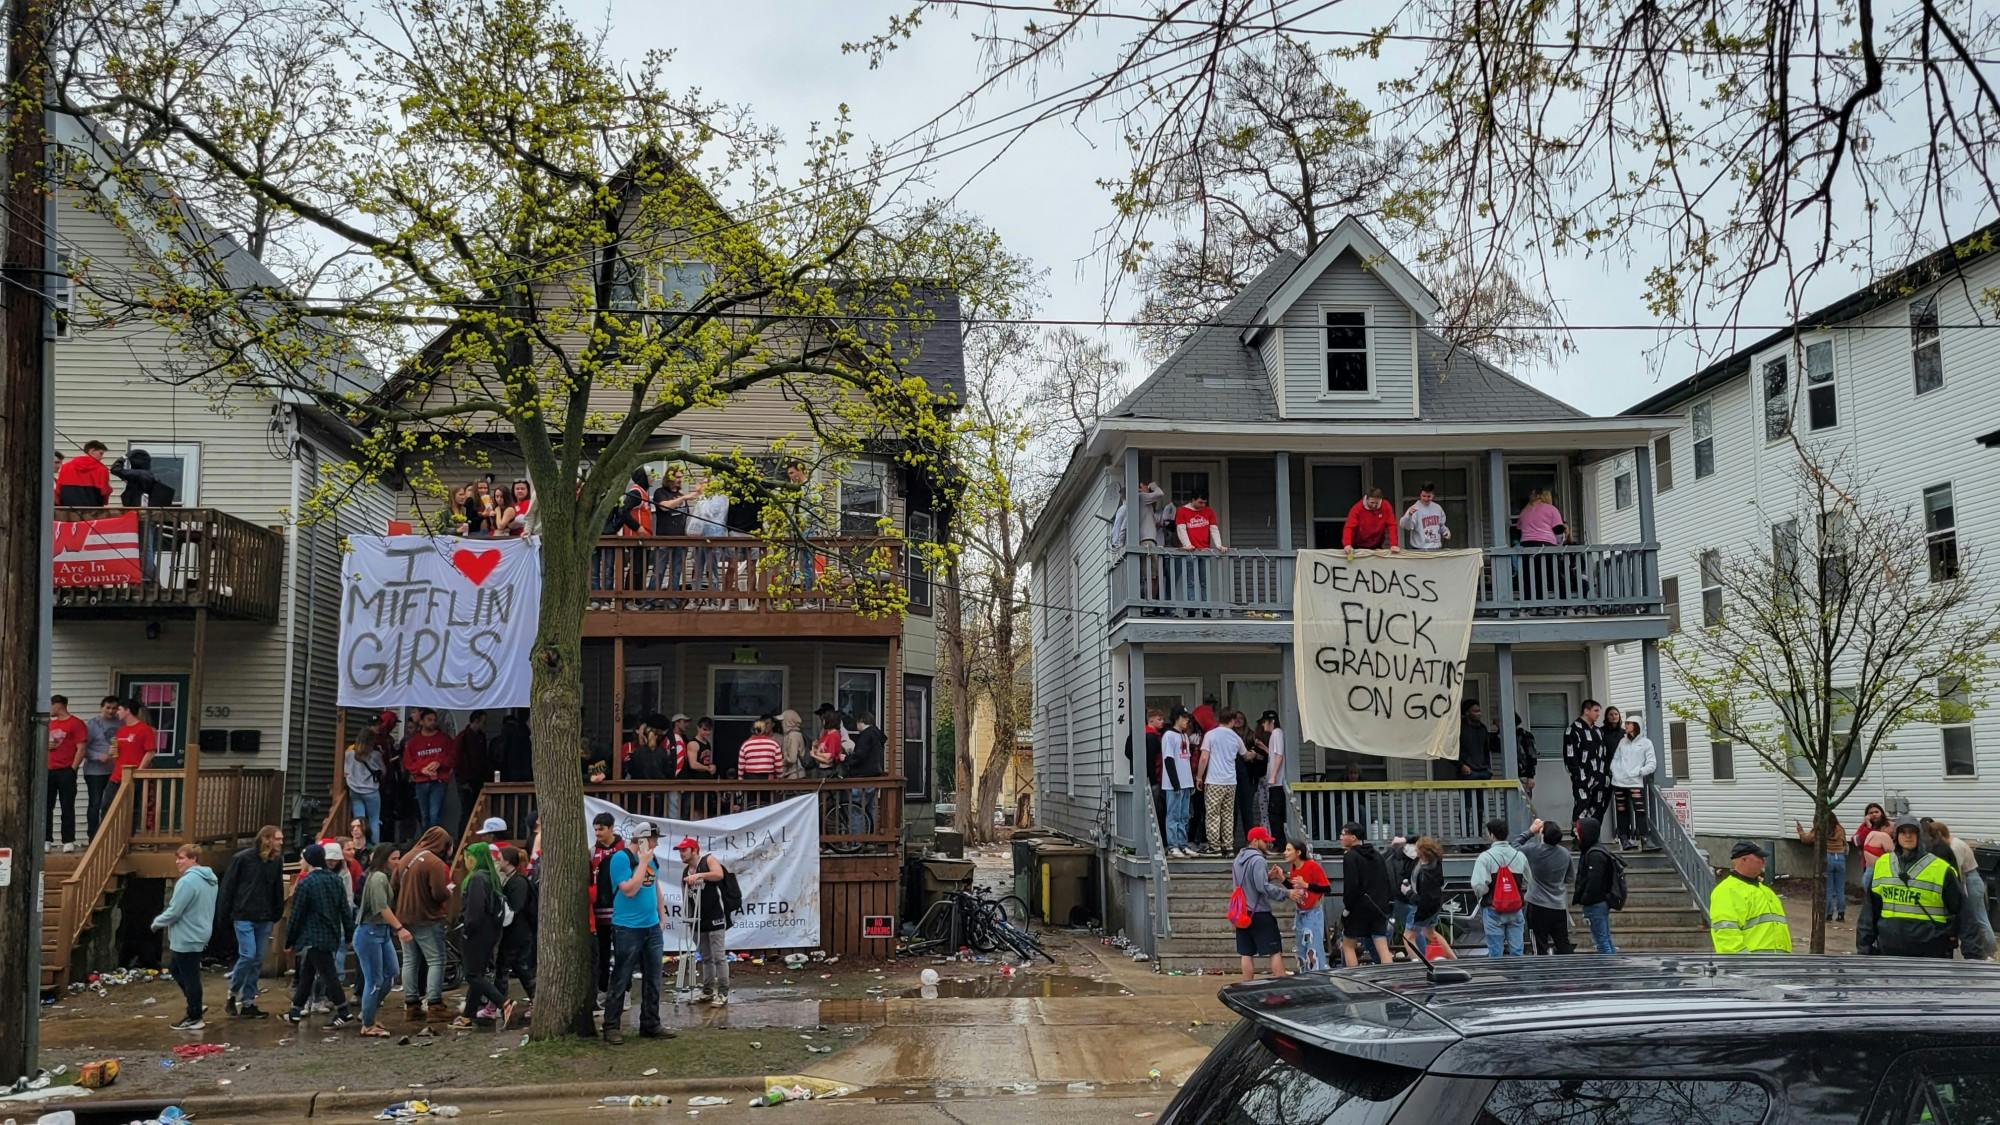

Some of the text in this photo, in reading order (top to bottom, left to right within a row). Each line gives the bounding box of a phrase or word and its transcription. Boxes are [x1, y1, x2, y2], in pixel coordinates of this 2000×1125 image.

[60, 561, 106, 574] Are In
[71, 573, 131, 585] Country
[384, 546, 437, 586] I
[1313, 561, 1439, 602] DEADASS
[347, 583, 515, 628] MIFFLIN
[1341, 602, 1437, 655] FUCK
[347, 628, 502, 692] GIRLS
[1316, 646, 1467, 689] GRADUATING
[1117, 681, 1125, 725] 524
[1347, 685, 1393, 720] ON
[1651, 682, 1660, 709] 522
[206, 706, 230, 718] 530
[686, 826, 792, 852] ERBAL
[733, 917, 806, 930] balaspect.com
[867, 926, 890, 935] PARKING
[874, 918, 883, 927] NO
